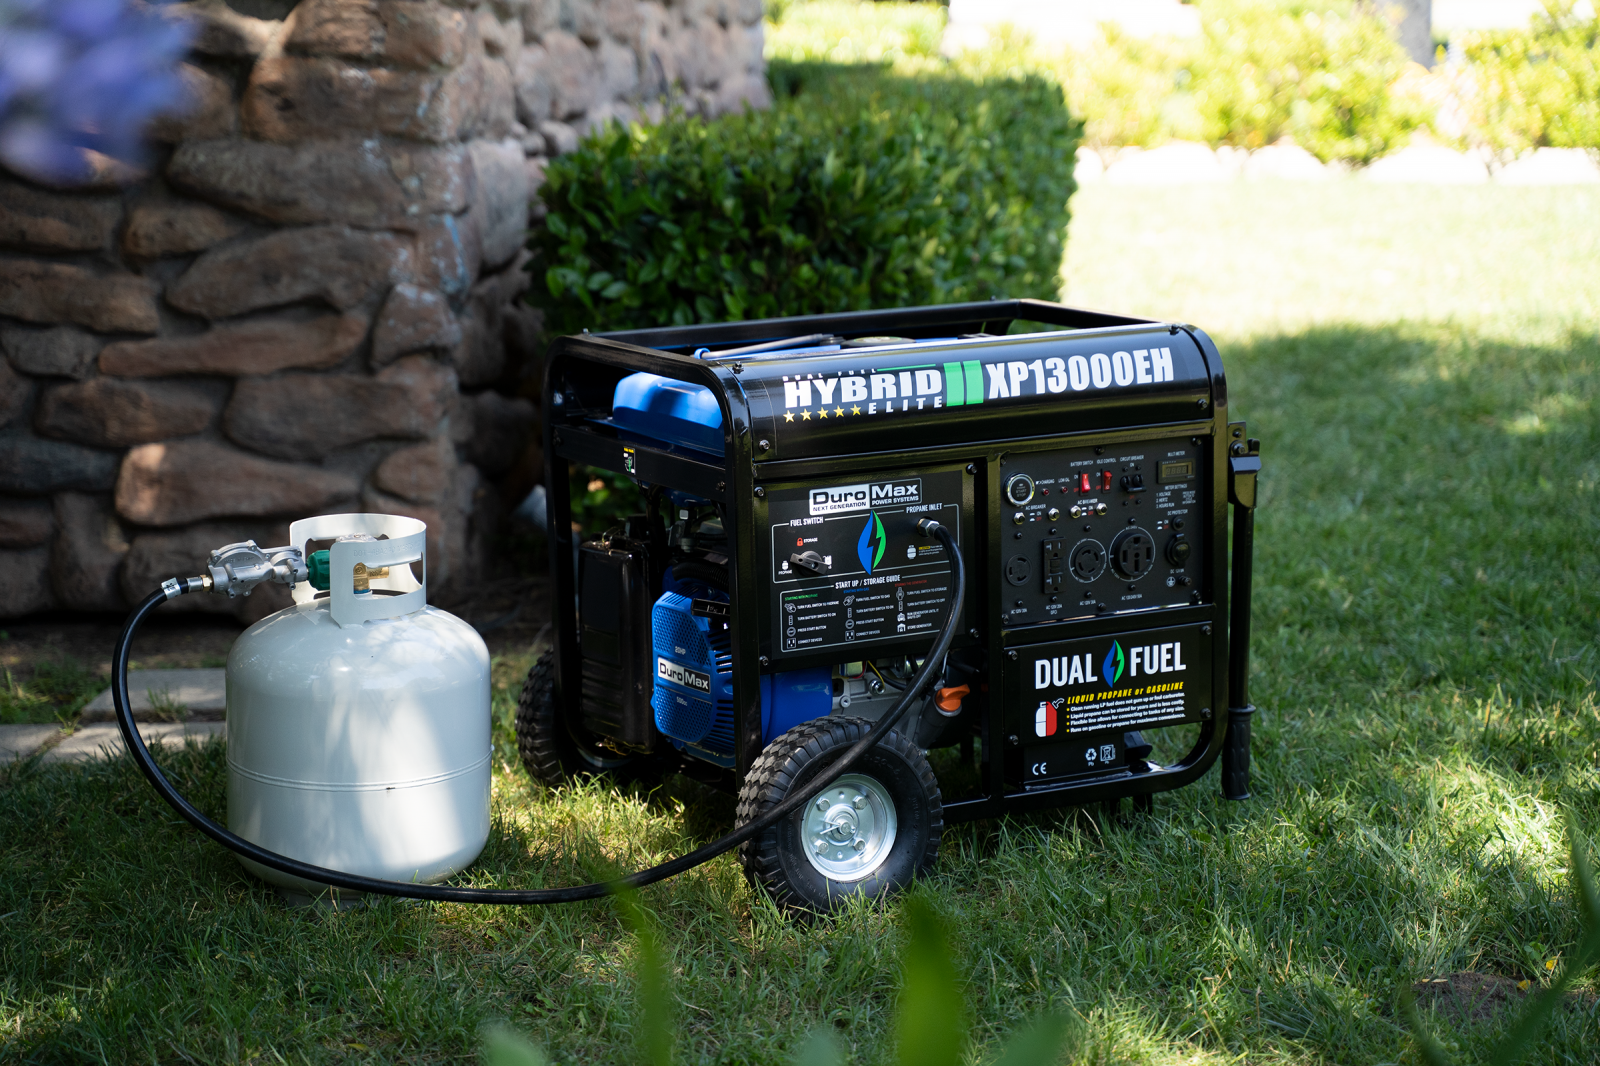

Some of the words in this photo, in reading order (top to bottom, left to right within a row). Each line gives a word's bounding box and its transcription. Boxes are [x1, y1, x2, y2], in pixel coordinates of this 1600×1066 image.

[782, 373, 823, 381] DUAL
[838, 368, 876, 376] FUEL
[985, 347, 1173, 399] XP13000EH
[784, 370, 942, 408] HYBRID
[868, 396, 942, 414] ELITE
[830, 502, 866, 510] GENERATION
[893, 496, 919, 504] SYSTEMS
[906, 504, 928, 514] PROPANE
[929, 502, 942, 511] INLET
[803, 516, 824, 525] SWITCH
[836, 581, 850, 590] START
[852, 580, 860, 588] UP
[864, 576, 886, 586] STORAGE
[886, 574, 900, 583] GUIDE
[674, 646, 686, 655] 20HP
[1035, 653, 1098, 689] DUAL
[1130, 642, 1186, 676] FUEL
[1067, 694, 1094, 704] LIQUID
[1097, 688, 1132, 700] PROPANE
[1146, 682, 1184, 694] GASOLINE
